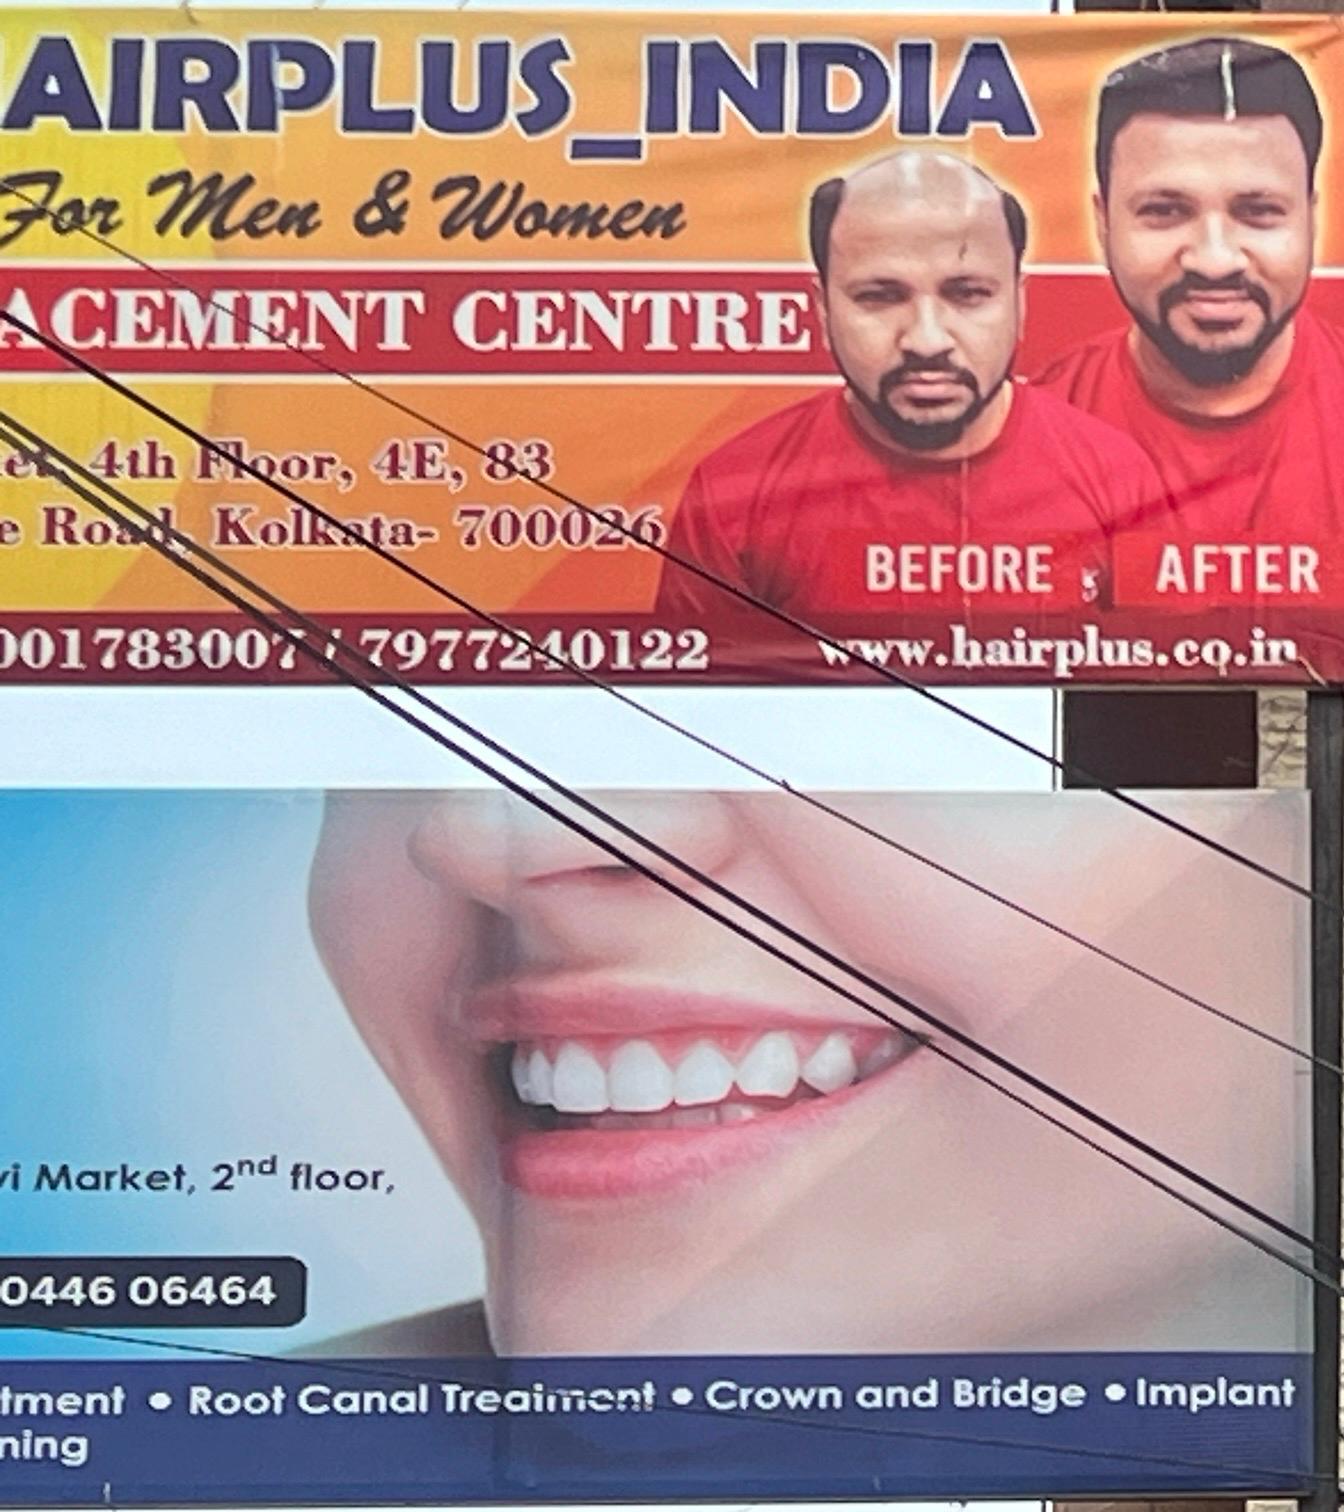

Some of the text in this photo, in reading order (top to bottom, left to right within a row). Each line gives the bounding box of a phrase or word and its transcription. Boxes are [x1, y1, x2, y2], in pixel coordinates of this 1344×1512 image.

[0, 169, 688, 248] For Men & Women
[0, 287, 810, 352] ACEMENT CENTRE
[89, 441, 177, 479] 4th
[198, 441, 354, 487] Floor,
[375, 443, 464, 484] 4E,
[485, 442, 551, 481] 83
[216, 506, 434, 546] Kolkata-
[457, 508, 666, 547] 700026
[866, 545, 1053, 593] BEFORE
[1155, 545, 1321, 593] AFTER
[360, 628, 708, 671] 7977240122
[818, 626, 1297, 678] www.hairplus.co.in
[34, 1163, 196, 1196] Market,
[290, 1163, 395, 1194] floor,
[0, 1275, 277, 1307] 0446 06464
[0, 1385, 126, 1416] tment
[190, 1386, 286, 1416] Root
[300, 1384, 428, 1415] Canal
[705, 1380, 842, 1409] Crown
[856, 1378, 938, 1408] and
[953, 1377, 1086, 1415] Bridge
[1137, 1378, 1296, 1413] Implant
[0, 1428, 89, 1467] ning
